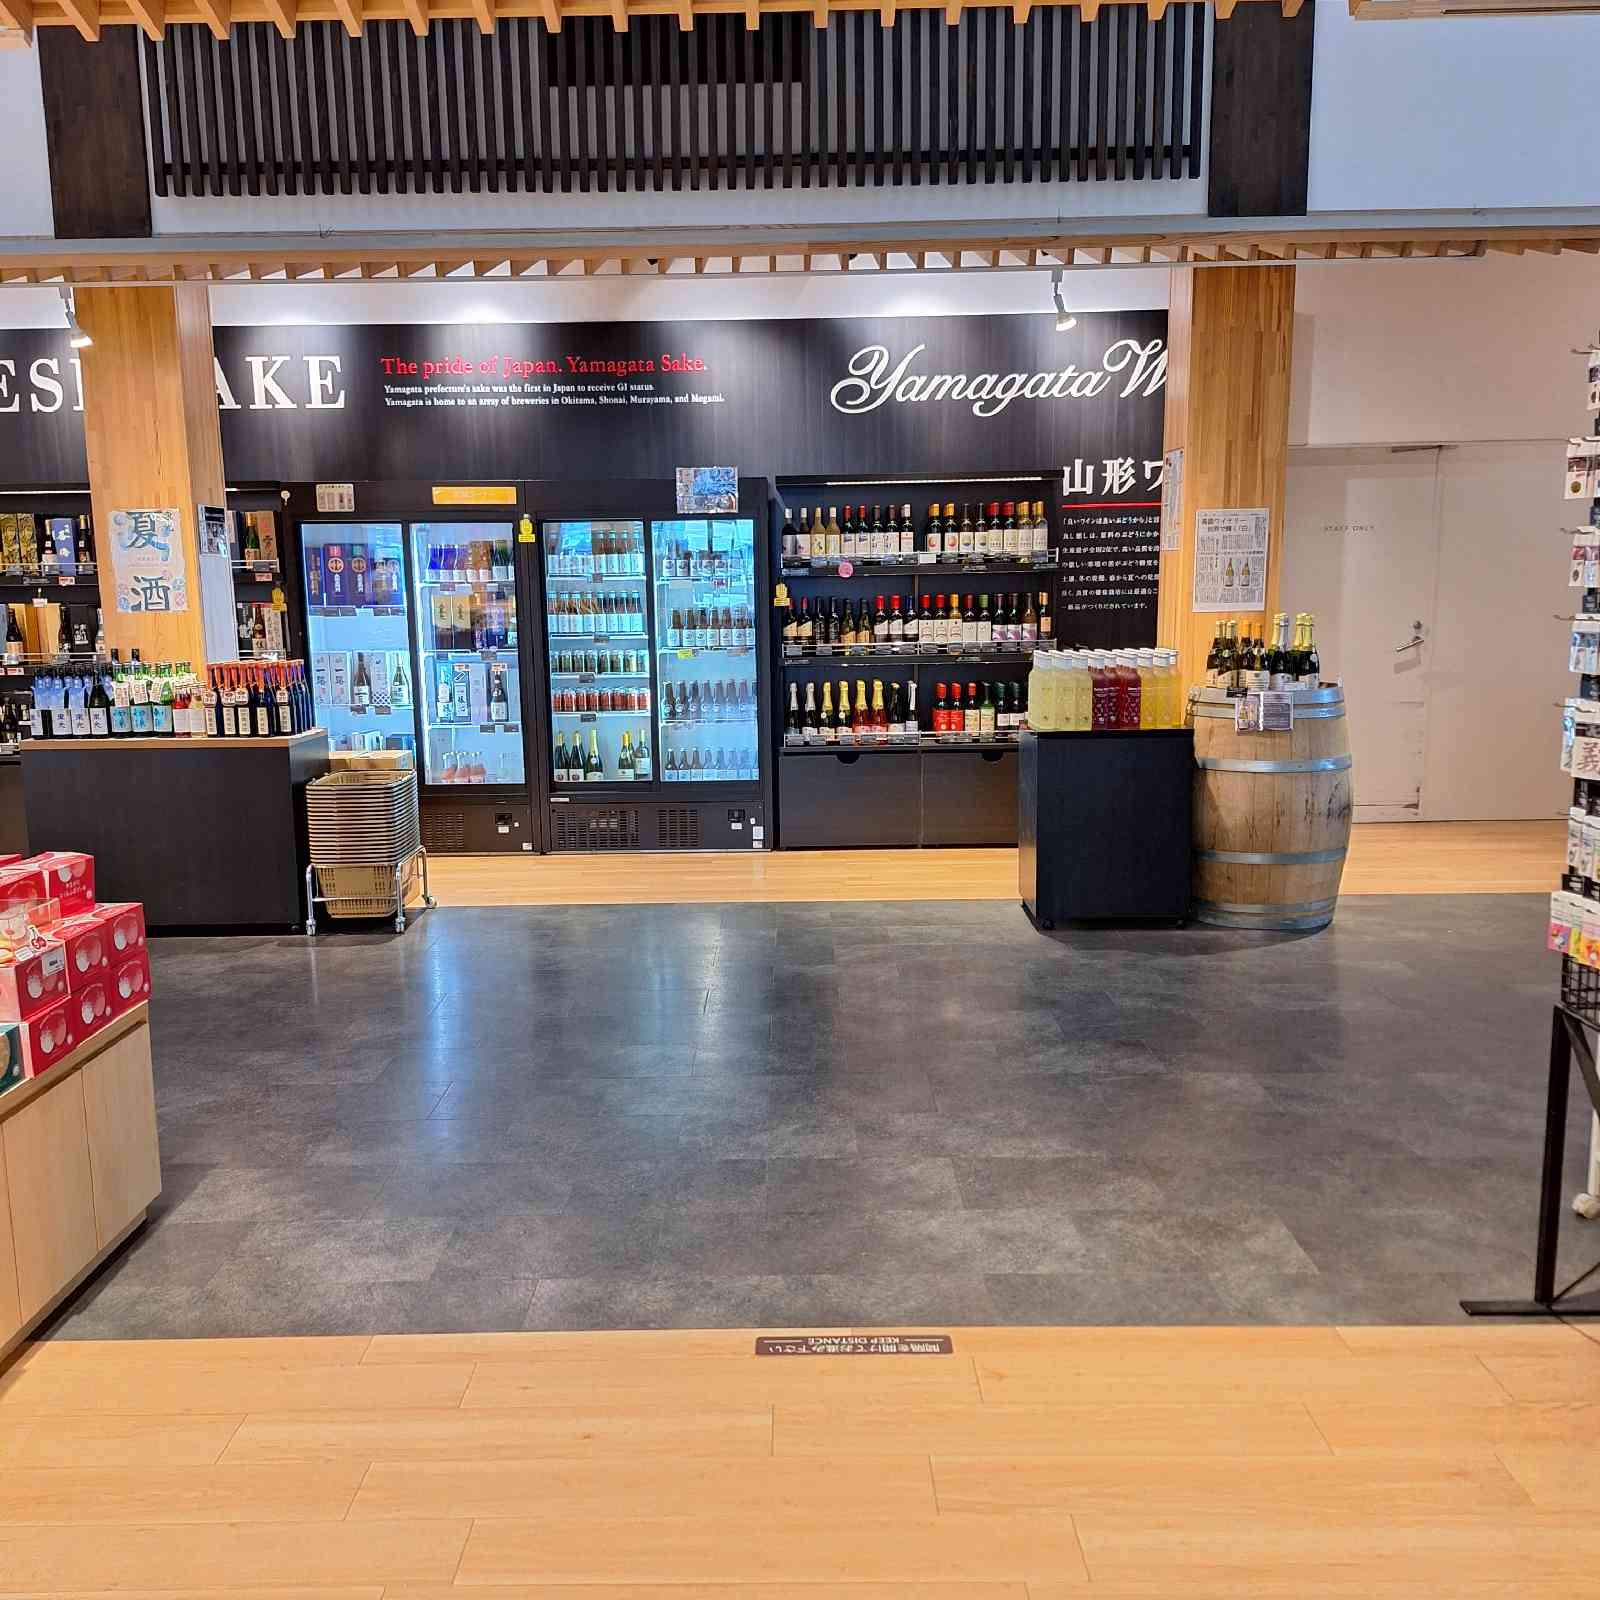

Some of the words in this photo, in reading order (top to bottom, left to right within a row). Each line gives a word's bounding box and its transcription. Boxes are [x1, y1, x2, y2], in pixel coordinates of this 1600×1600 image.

[381, 356, 418, 375] The
[423, 354, 473, 380] pride
[479, 354, 499, 374] of
[503, 355, 562, 379] Japan.
[565, 355, 656, 377] Yamagata
[660, 351, 708, 372] Sake.
[384, 385, 423, 395] Yamagata
[472, 384, 491, 393] sake
[491, 384, 508, 393] was
[509, 384, 522, 393] the
[524, 383, 541, 393] first
[543, 384, 551, 392] in
[552, 383, 575, 394] Japan
[577, 383, 586, 392] to
[587, 383, 615, 392] receive
[830, 344, 1111, 417] Yamagata
[385, 398, 424, 409] Yamagata
[425, 397, 432, 406] is
[434, 396, 456, 406] home
[457, 397, 466, 406] to
[467, 398, 478, 406] an
[479, 397, 500, 408] array
[501, 396, 510, 405] of
[511, 395, 549, 405] breweries
[551, 396, 560, 405] in
[675, 393, 689, 404] and
